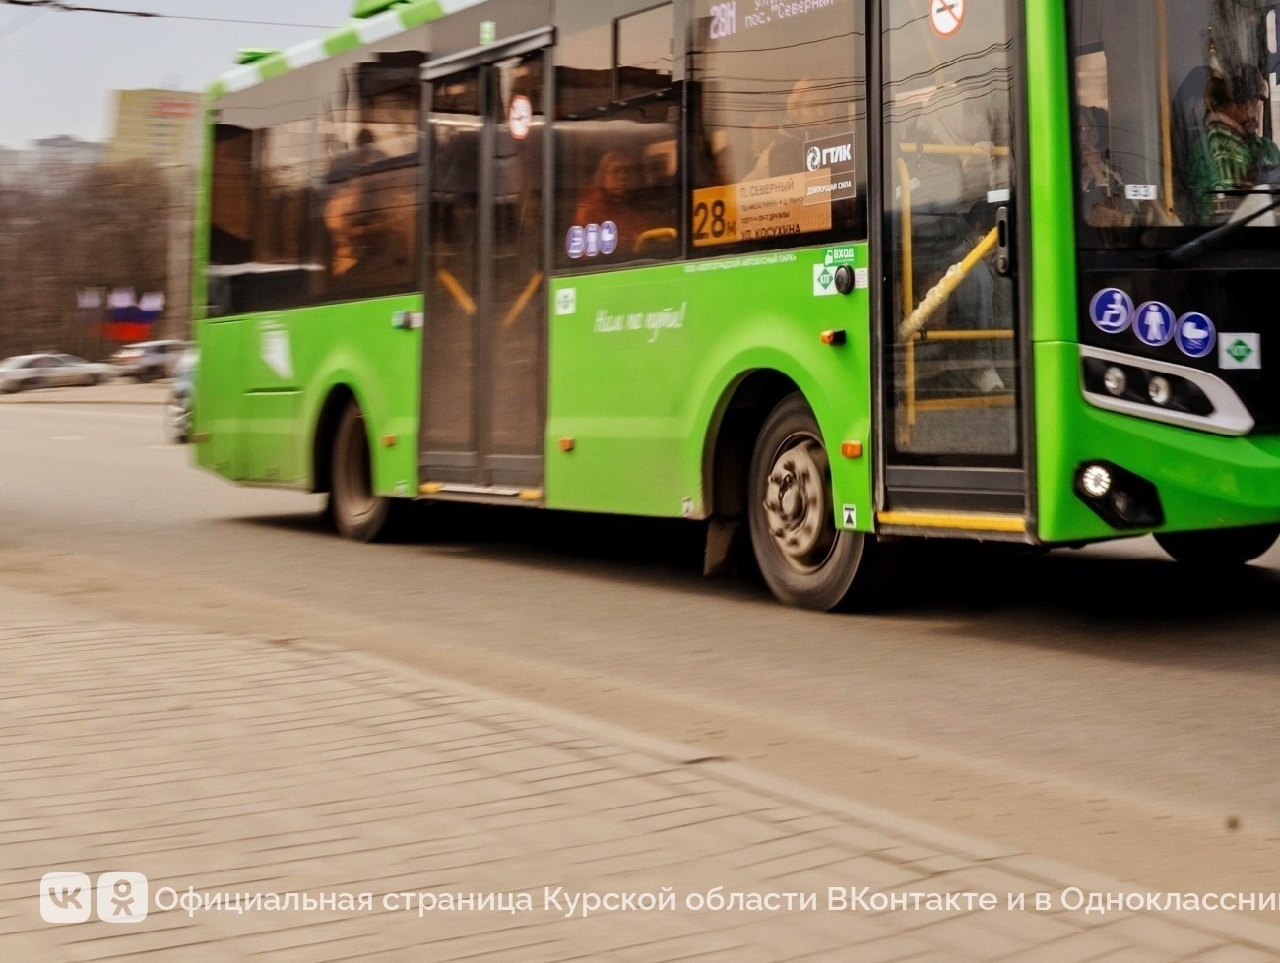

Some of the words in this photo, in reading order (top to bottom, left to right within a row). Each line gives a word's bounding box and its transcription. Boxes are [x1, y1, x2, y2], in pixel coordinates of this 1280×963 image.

[822, 143, 852, 166] ГТЛК
[750, 177, 794, 197] СЕВЕРНЫЙ
[838, 180, 852, 190] СИЛА
[833, 247, 855, 259] ВХОД
